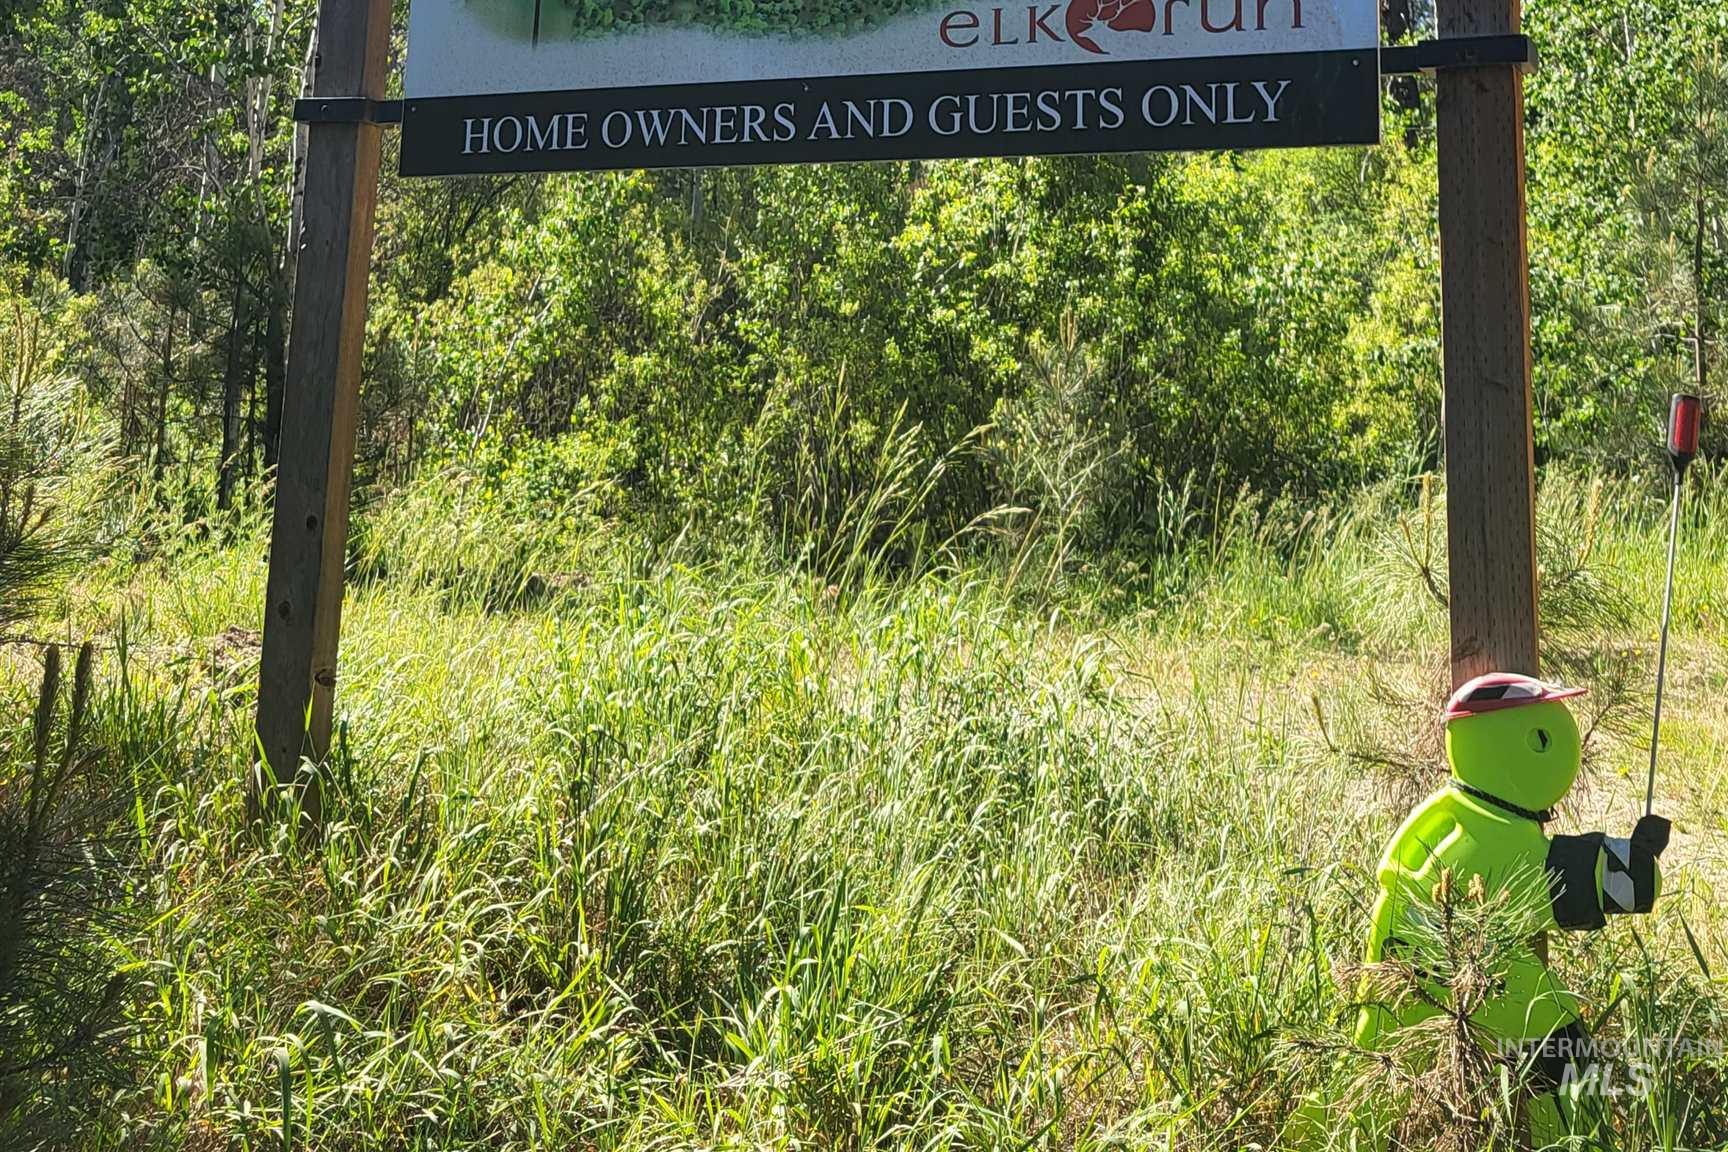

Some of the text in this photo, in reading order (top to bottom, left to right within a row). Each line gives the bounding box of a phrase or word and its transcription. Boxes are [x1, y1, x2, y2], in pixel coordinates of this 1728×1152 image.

[461, 79, 1292, 155] HOME OWNERS AND GUESTS ONLY
